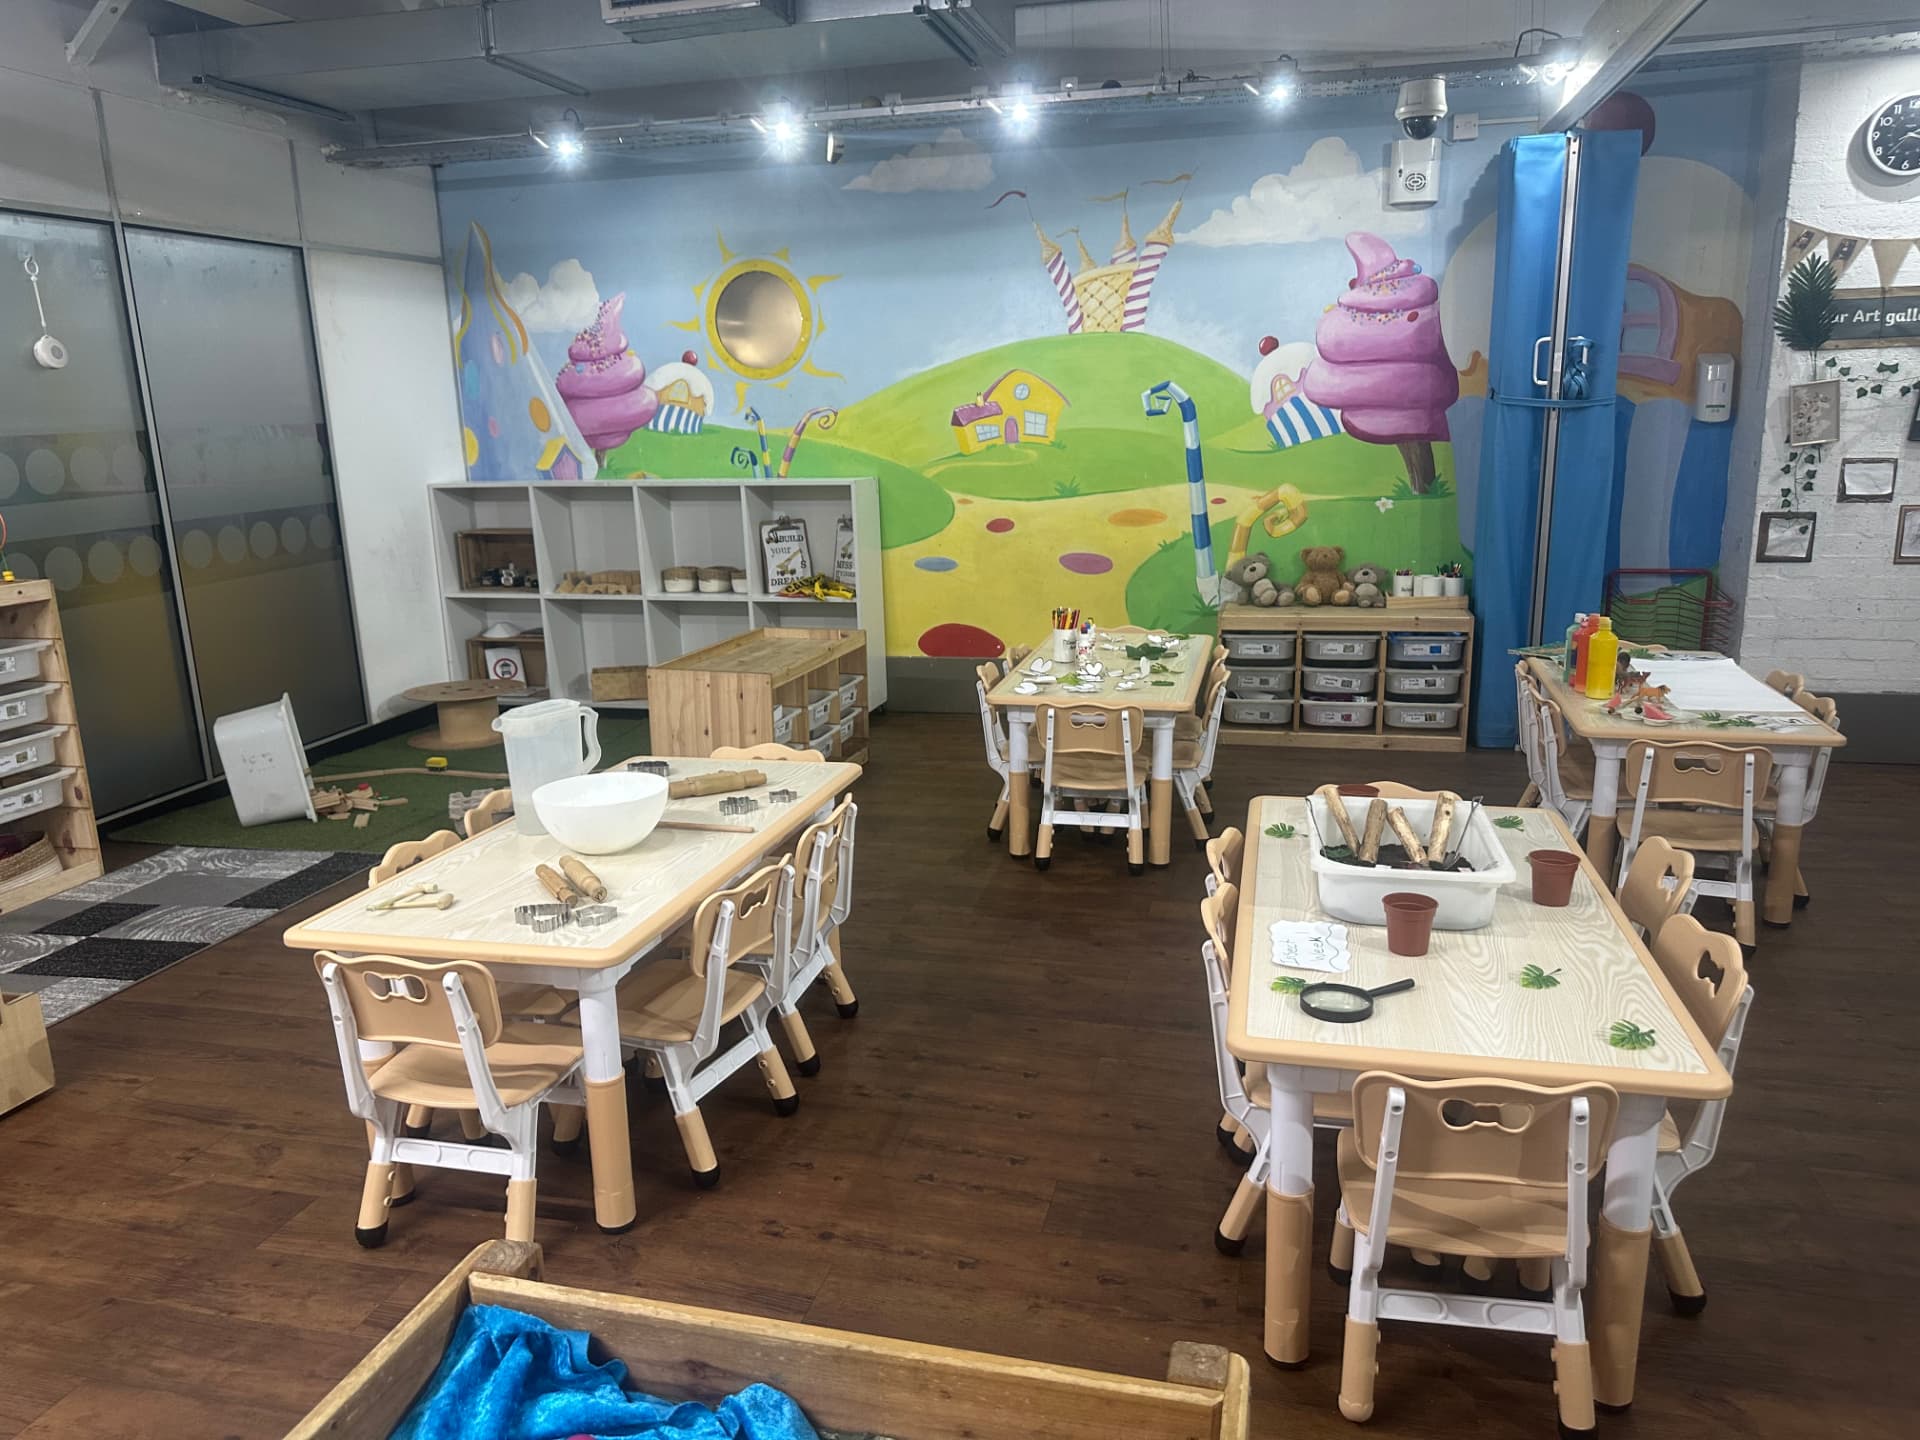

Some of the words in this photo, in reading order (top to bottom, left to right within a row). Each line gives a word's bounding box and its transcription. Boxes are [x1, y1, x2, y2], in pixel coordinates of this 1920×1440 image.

[1894, 104, 1902, 115] 11
[1880, 116, 1893, 127] 10
[1872, 131, 1880, 141] 9
[1875, 146, 1883, 156] 8
[1887, 155, 1896, 166] 7
[1901, 160, 1909, 170] 6
[1852, 309, 1881, 323] Art
[1884, 307, 1920, 327] gall
[778, 535, 804, 543] BUILD
[770, 546, 792, 558] your
